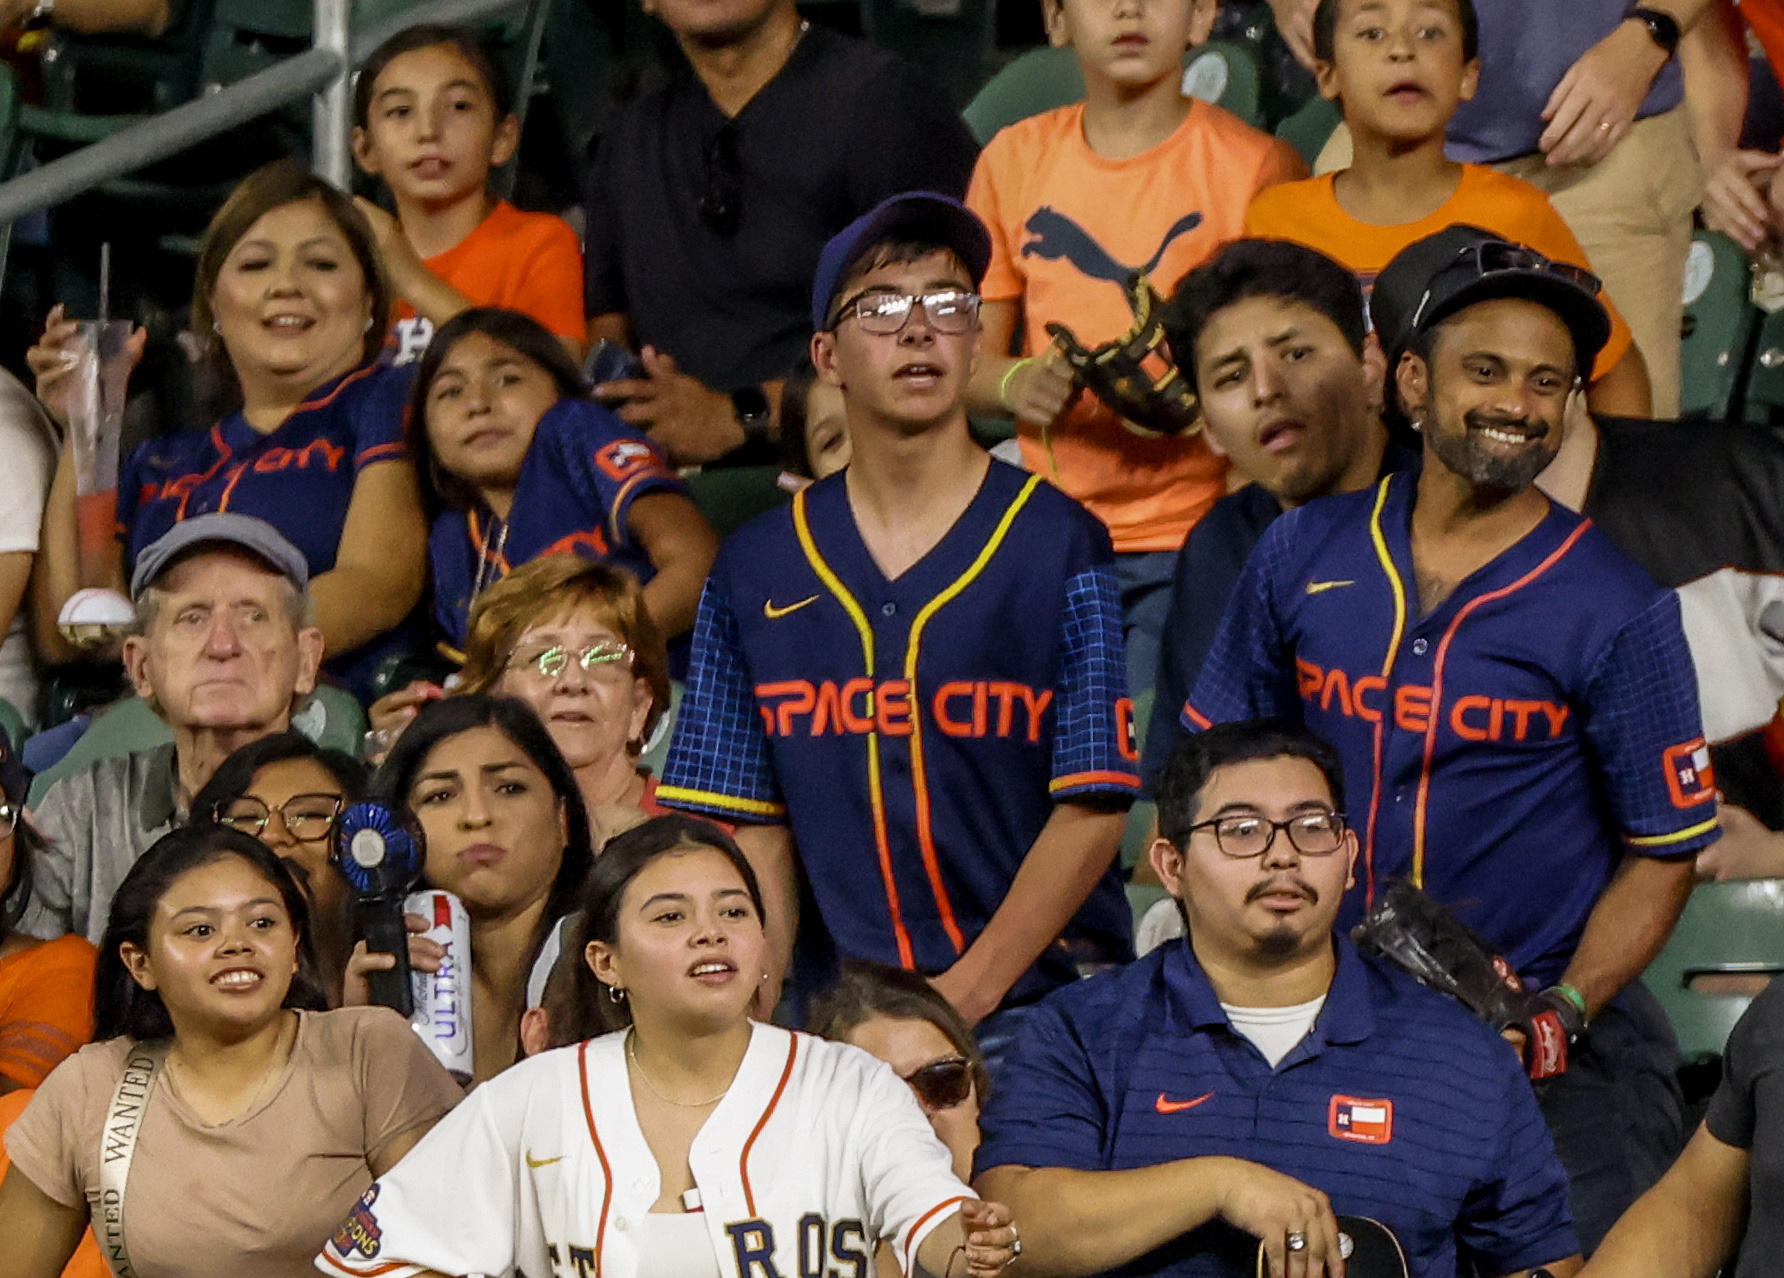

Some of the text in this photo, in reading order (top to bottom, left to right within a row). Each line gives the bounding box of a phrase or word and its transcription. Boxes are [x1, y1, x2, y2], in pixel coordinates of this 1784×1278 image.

[932, 680, 1053, 743] CITY
[1296, 657, 1570, 742] PACE CITY
[434, 941, 457, 1039] ULTRA
[104, 1056, 155, 1164] WANTED
